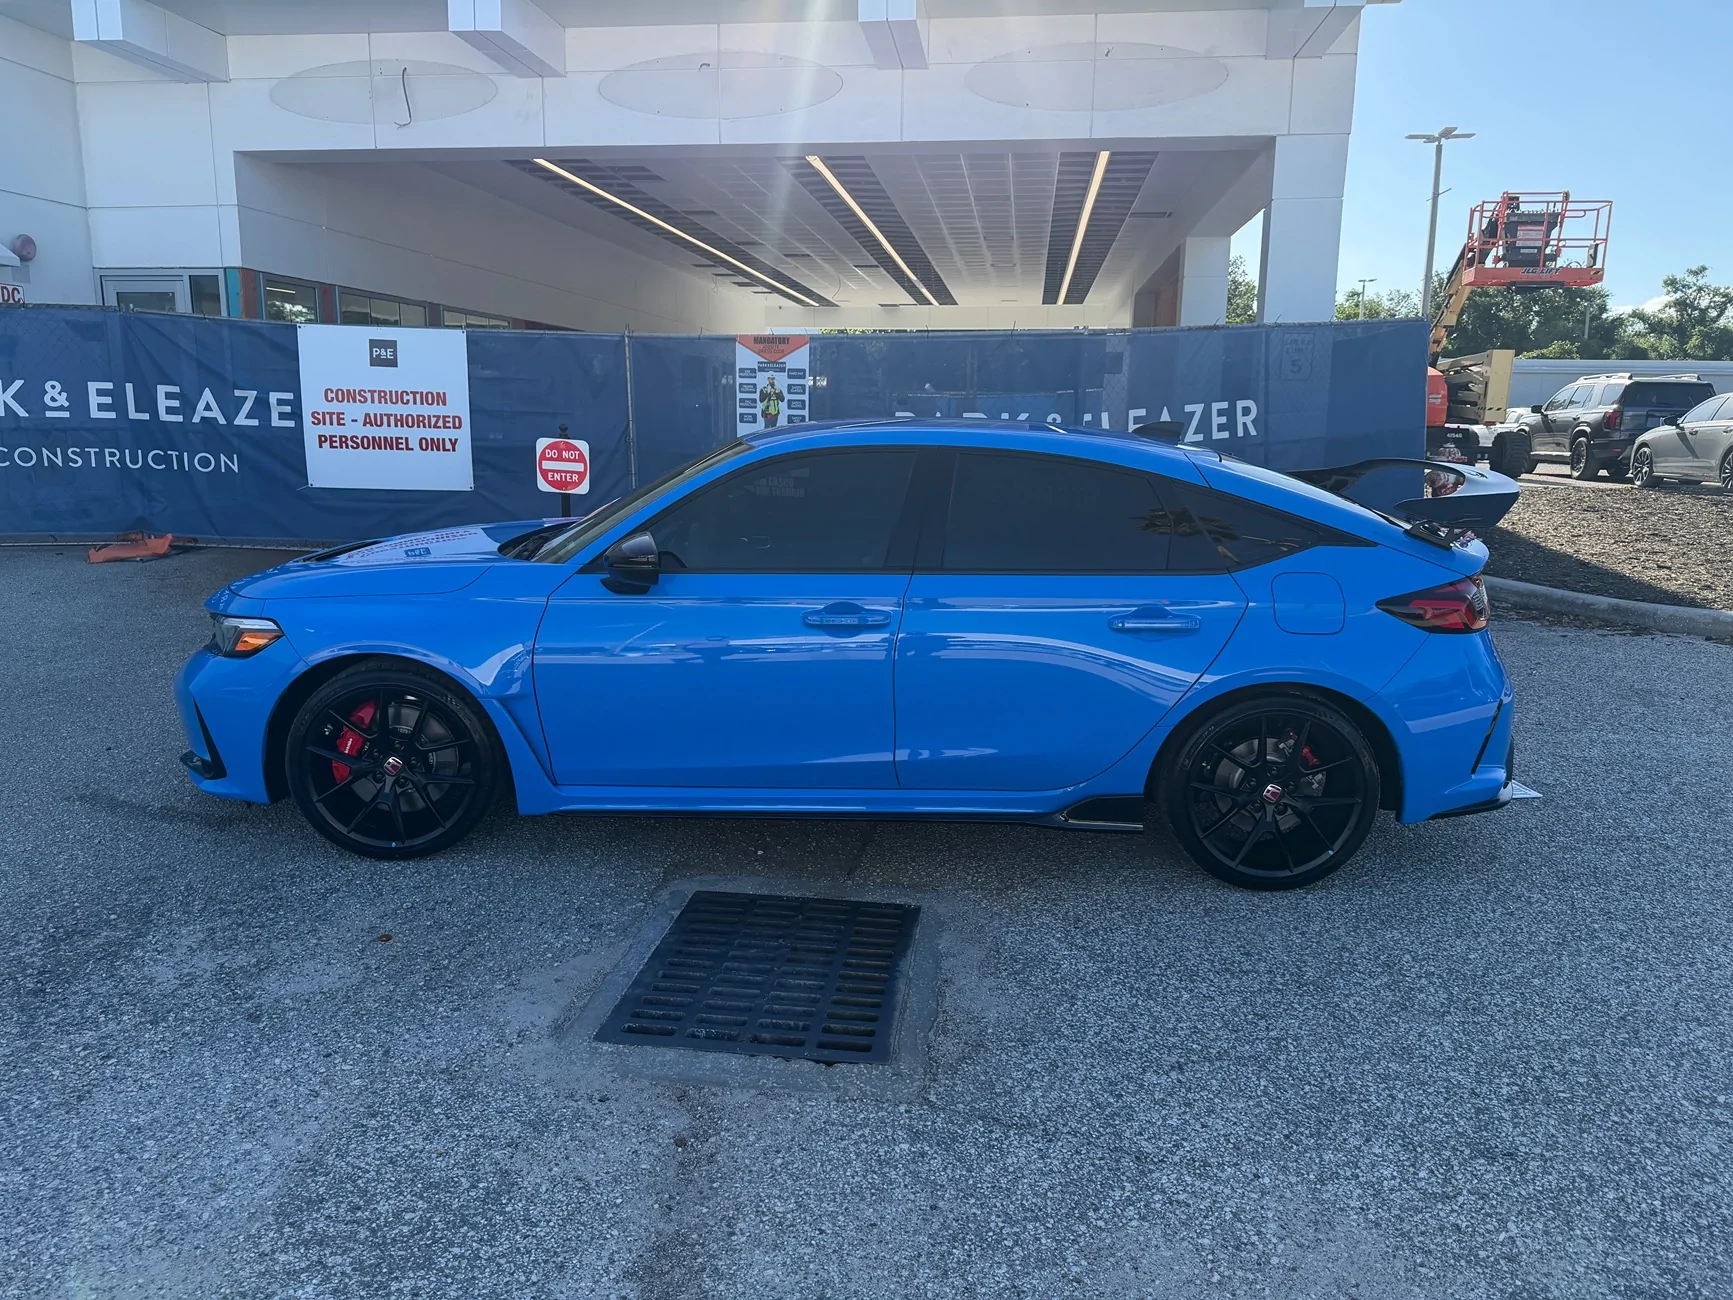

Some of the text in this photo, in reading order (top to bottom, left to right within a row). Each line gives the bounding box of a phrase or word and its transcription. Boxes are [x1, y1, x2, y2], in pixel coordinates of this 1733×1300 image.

[1520, 267, 1561, 275] JLG LIFT
[753, 336, 790, 345] MANDATORY
[373, 347, 394, 359] P&E
[43, 380, 70, 417] &
[323, 388, 447, 406] CONSTRUCTION
[310, 411, 346, 427] SITE
[362, 412, 463, 430] AUTHORIZED
[317, 434, 459, 452] PERSONNEL ONLY
[545, 449, 580, 460] DO NOT
[547, 472, 579, 483] ENTER
